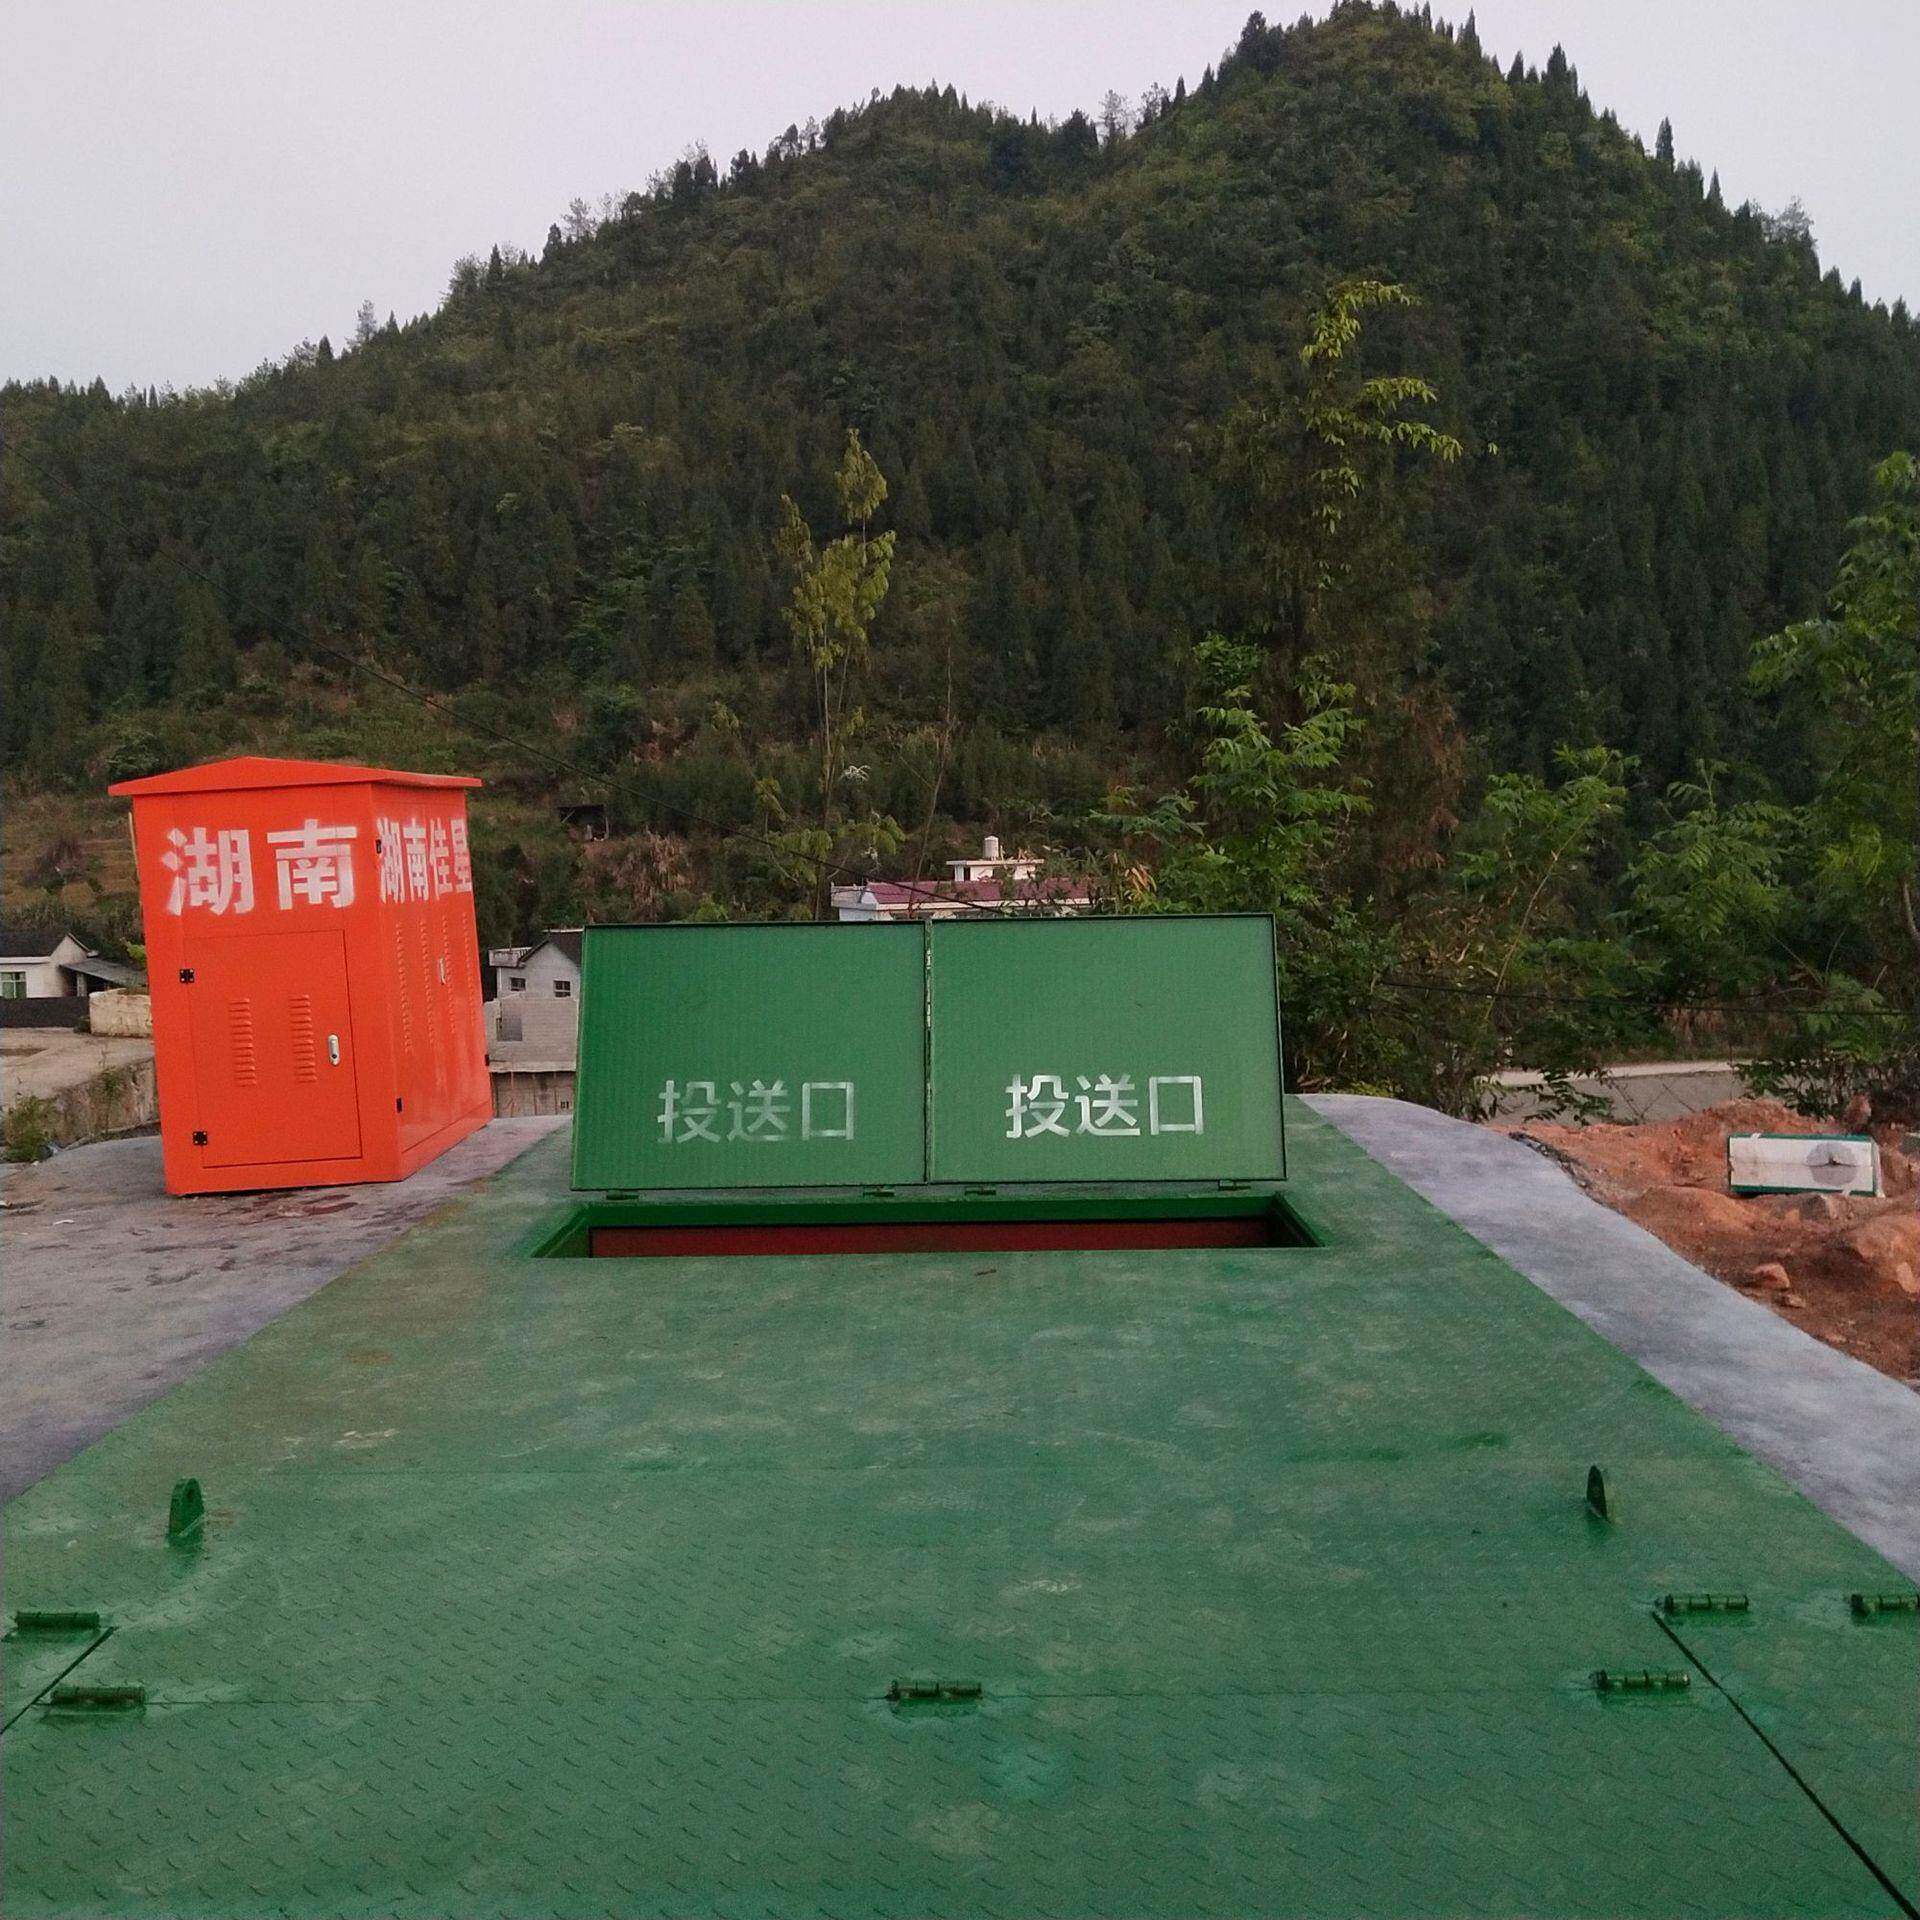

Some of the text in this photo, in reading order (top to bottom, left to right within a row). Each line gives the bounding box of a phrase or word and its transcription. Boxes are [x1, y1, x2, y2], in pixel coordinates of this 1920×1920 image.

[163, 820, 357, 915] 湖南
[657, 1079, 854, 1143] 投送口
[1005, 1074, 1204, 1138] 投送口
